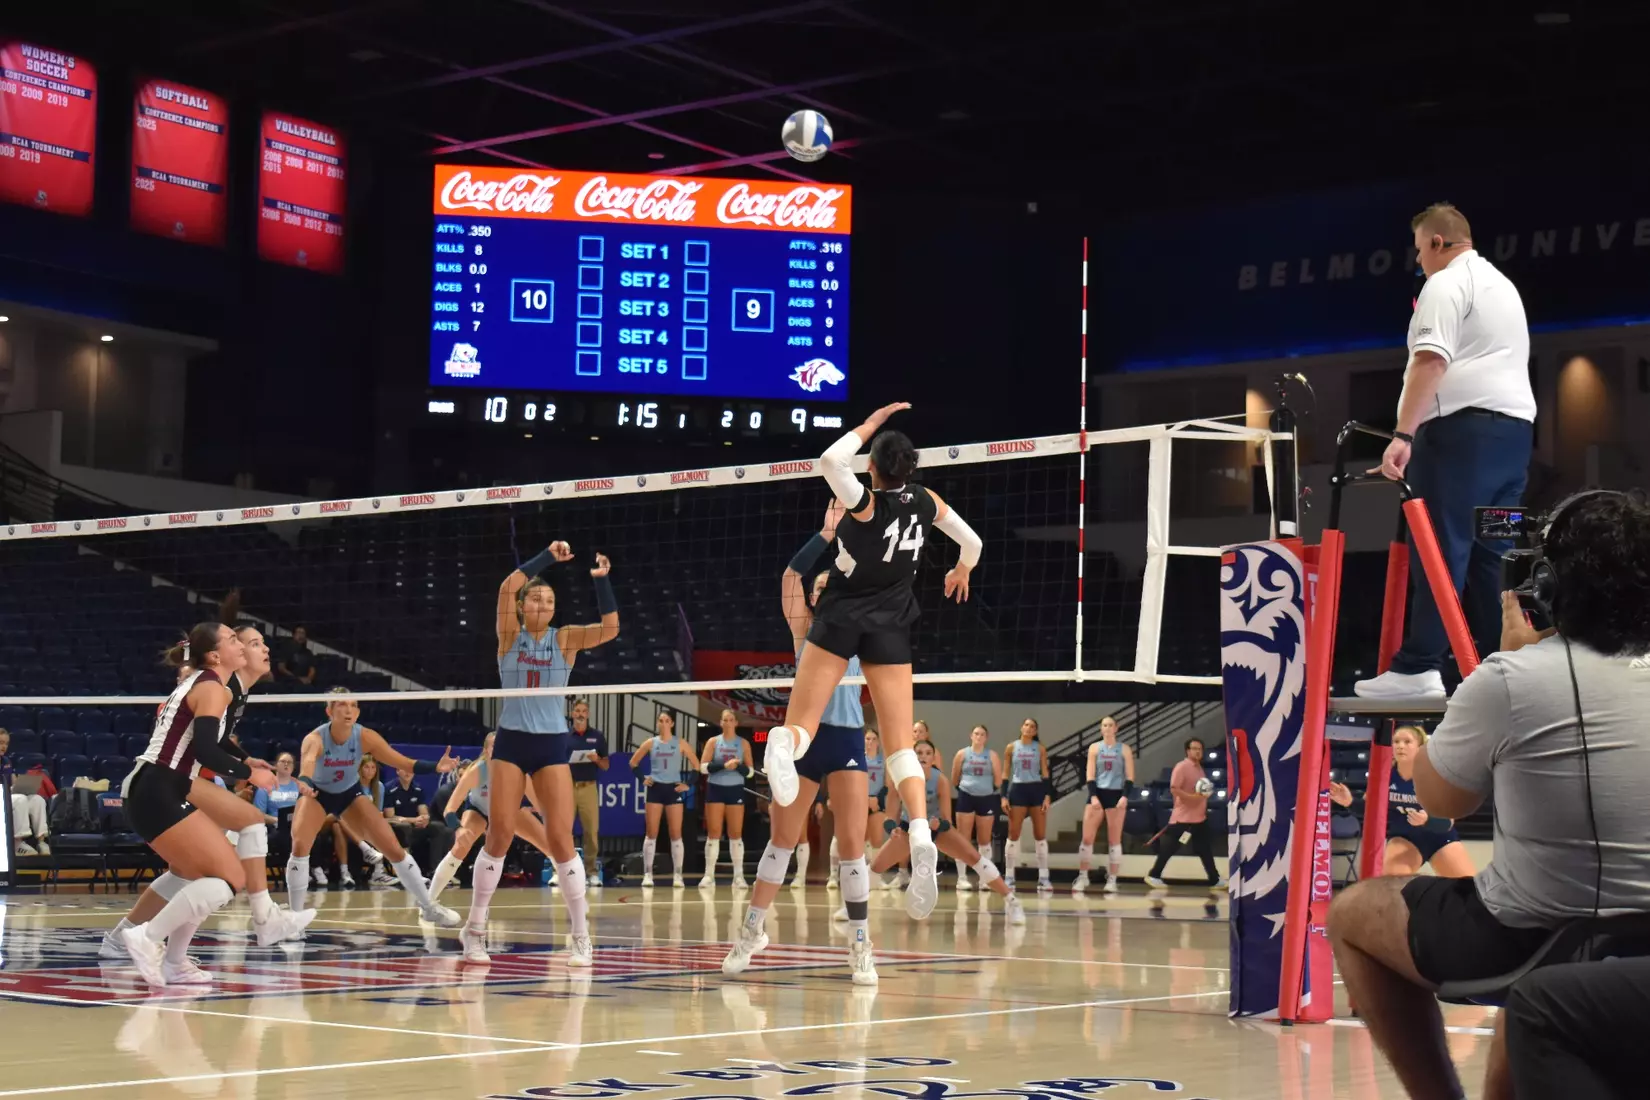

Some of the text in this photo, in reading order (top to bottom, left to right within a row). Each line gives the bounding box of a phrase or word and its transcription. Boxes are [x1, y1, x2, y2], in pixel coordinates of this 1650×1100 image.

[21, 44, 76, 69] WOMEN'S
[26, 59, 69, 80] SOCCER
[0, 80, 17, 94] 008
[4, 69, 86, 97] CONFERENCE CHAMPIONS
[155, 86, 209, 110] SOFTBALL
[136, 117, 157, 131] 2025
[145, 107, 219, 133] CONFERENCE CHAMPIONS
[275, 118, 336, 146] VOLLEYBALL
[0, 144, 41, 163] 008 2019
[12, 136, 75, 158] NCAA TOURNAMENT
[271, 141, 339, 165] CONFERENCE CHAMPIONS
[152, 171, 209, 191] NCAA TOURNAMENT
[441, 171, 562, 213] Coca-Cola
[574, 176, 705, 221] Coca-Cola
[292, 205, 330, 220] TOURNAMENT
[717, 183, 844, 228] Coca-Cola
[437, 224, 491, 237] ATT% .350
[436, 243, 483, 256] KILLS 8
[621, 242, 668, 260] SET 1
[789, 240, 842, 254] ATT% .316
[435, 262, 487, 275] BLKS 0.0
[789, 259, 834, 272] KILLS 6
[1238, 247, 1417, 291] BELMO
[435, 282, 481, 294] ACES 1
[620, 271, 670, 288] SET 2
[788, 278, 839, 291] BLKS 0.0
[434, 301, 484, 313] DIGS 12
[522, 289, 547, 310] 10
[619, 300, 669, 317] SET 3
[746, 298, 761, 319] 9
[788, 298, 833, 309] ACES 1
[433, 320, 480, 332] ASTS 7
[788, 316, 834, 328] DIGS 9
[619, 328, 668, 345] SET 4
[787, 335, 833, 347] ASTS 6
[618, 357, 668, 374] SET 5
[485, 397, 508, 422] 10
[524, 403, 556, 421] 0 2
[617, 402, 658, 429] 1:15
[679, 413, 686, 429] 1
[721, 410, 762, 429] 2 0
[791, 408, 807, 433] 9
[31, 523, 57, 534] BELMONT
[97, 518, 127, 529] BRUINS
[168, 513, 198, 526] BELMONT
[241, 507, 274, 520] BRUINS
[320, 501, 352, 513] BELMONT
[400, 494, 437, 506] BRUINS
[486, 487, 521, 500] BELMONT
[574, 478, 615, 492] BRUINS
[670, 470, 711, 484] BELMONT
[769, 460, 814, 476] BRUINS
[986, 440, 1037, 456] BRUINS
[882, 513, 924, 563] 14
[333, 770, 345, 783] 3
[1389, 792, 1419, 803] BELMON
[661, 1056, 956, 1081] BYRD
